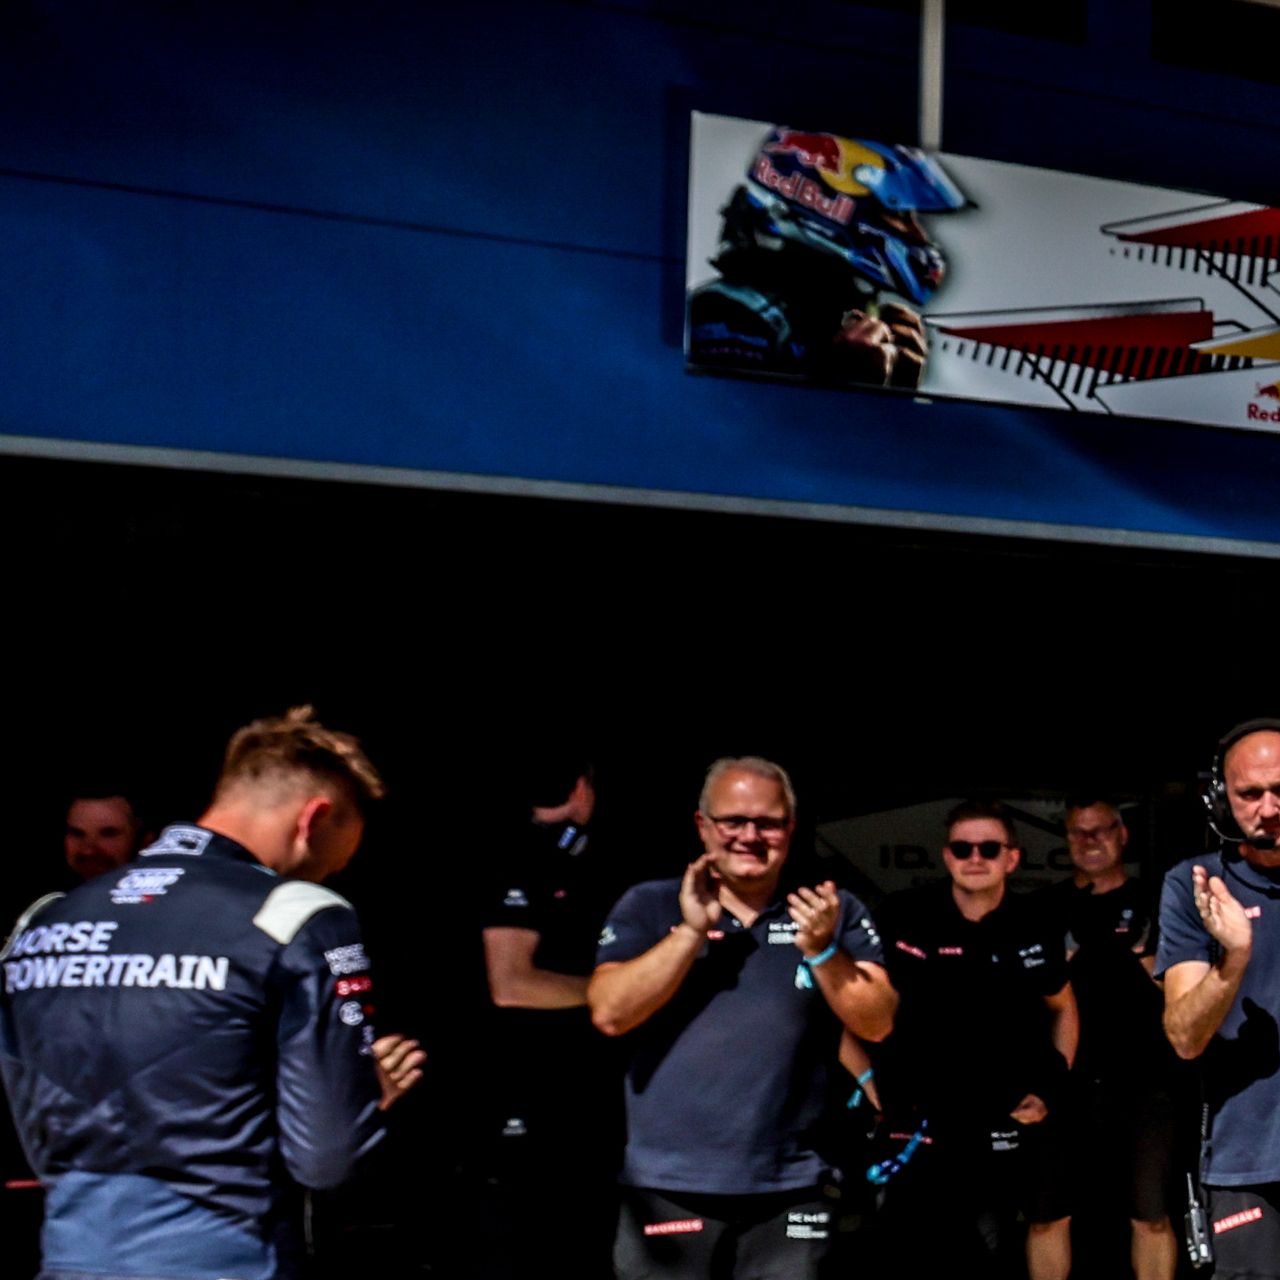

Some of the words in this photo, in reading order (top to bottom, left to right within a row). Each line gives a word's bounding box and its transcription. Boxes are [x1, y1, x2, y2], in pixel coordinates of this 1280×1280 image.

[1247, 403, 1280, 423] Red
[10, 921, 119, 956] HORSE
[3, 954, 230, 994] POWERTRAIN
